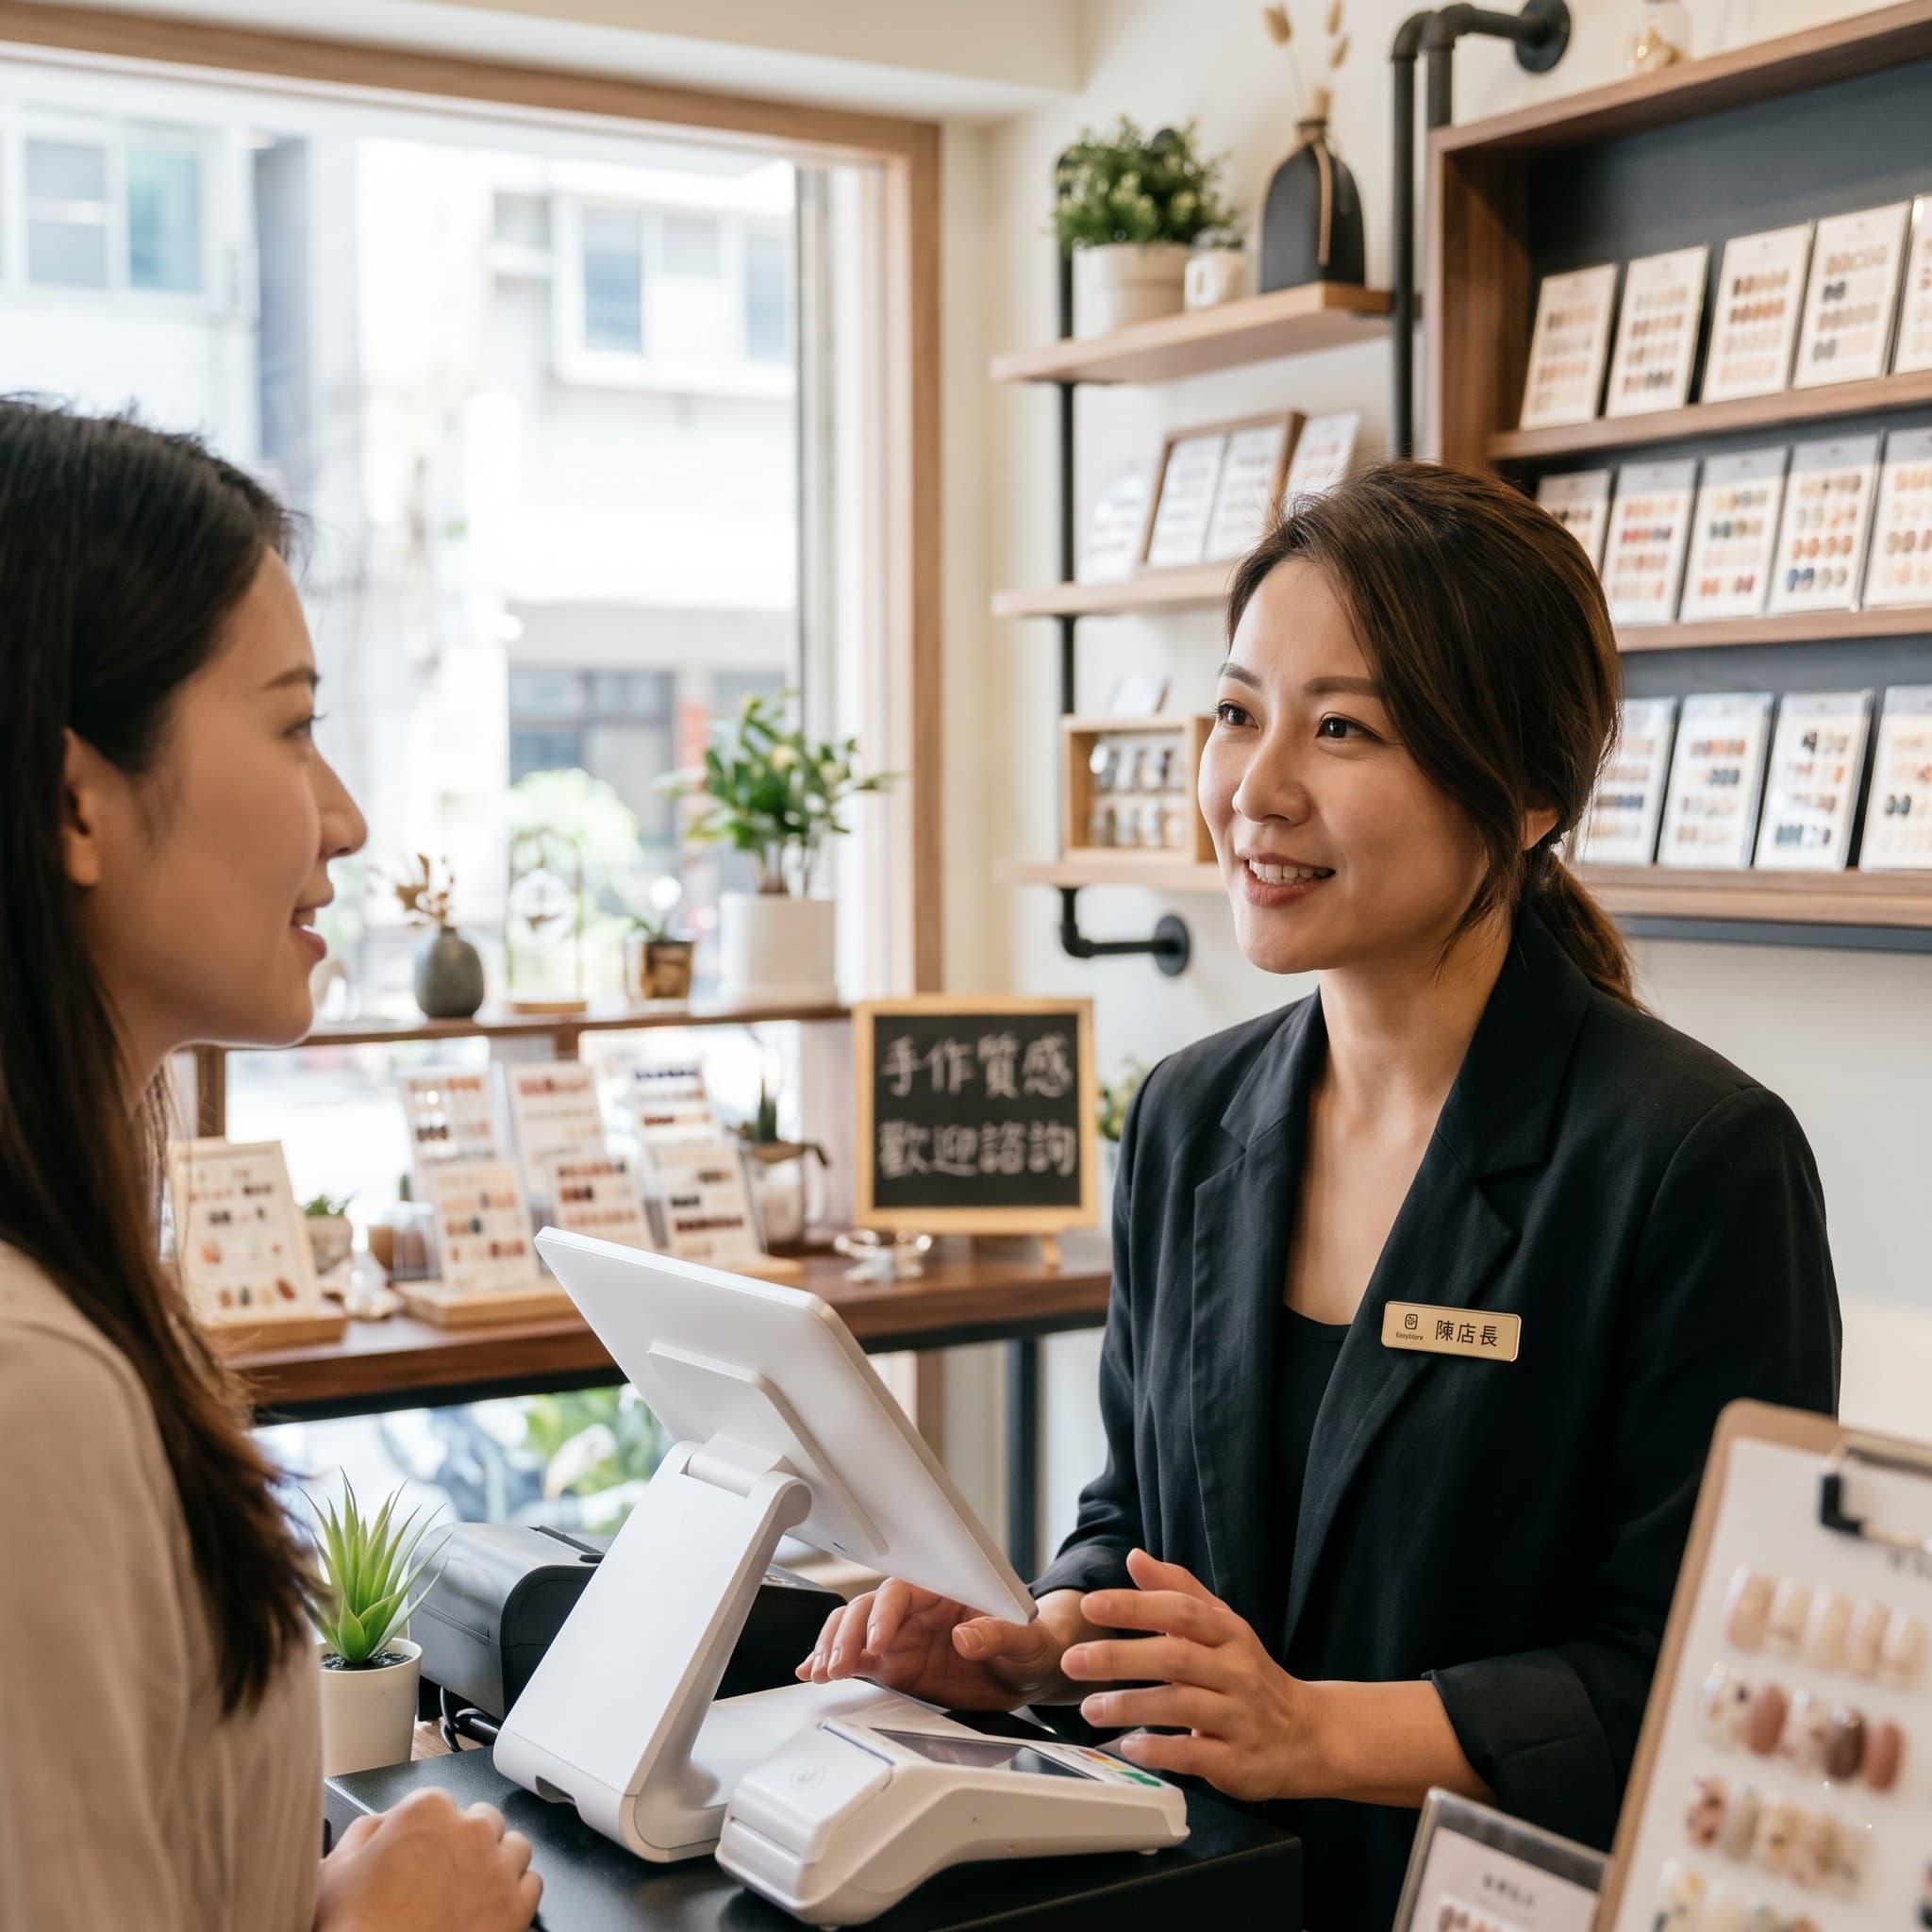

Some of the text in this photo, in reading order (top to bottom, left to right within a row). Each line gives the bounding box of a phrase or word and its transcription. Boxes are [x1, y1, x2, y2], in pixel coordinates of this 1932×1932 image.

[881, 1032, 1074, 1098] 手作質感
[1435, 1320, 1497, 1347] 陳店長
